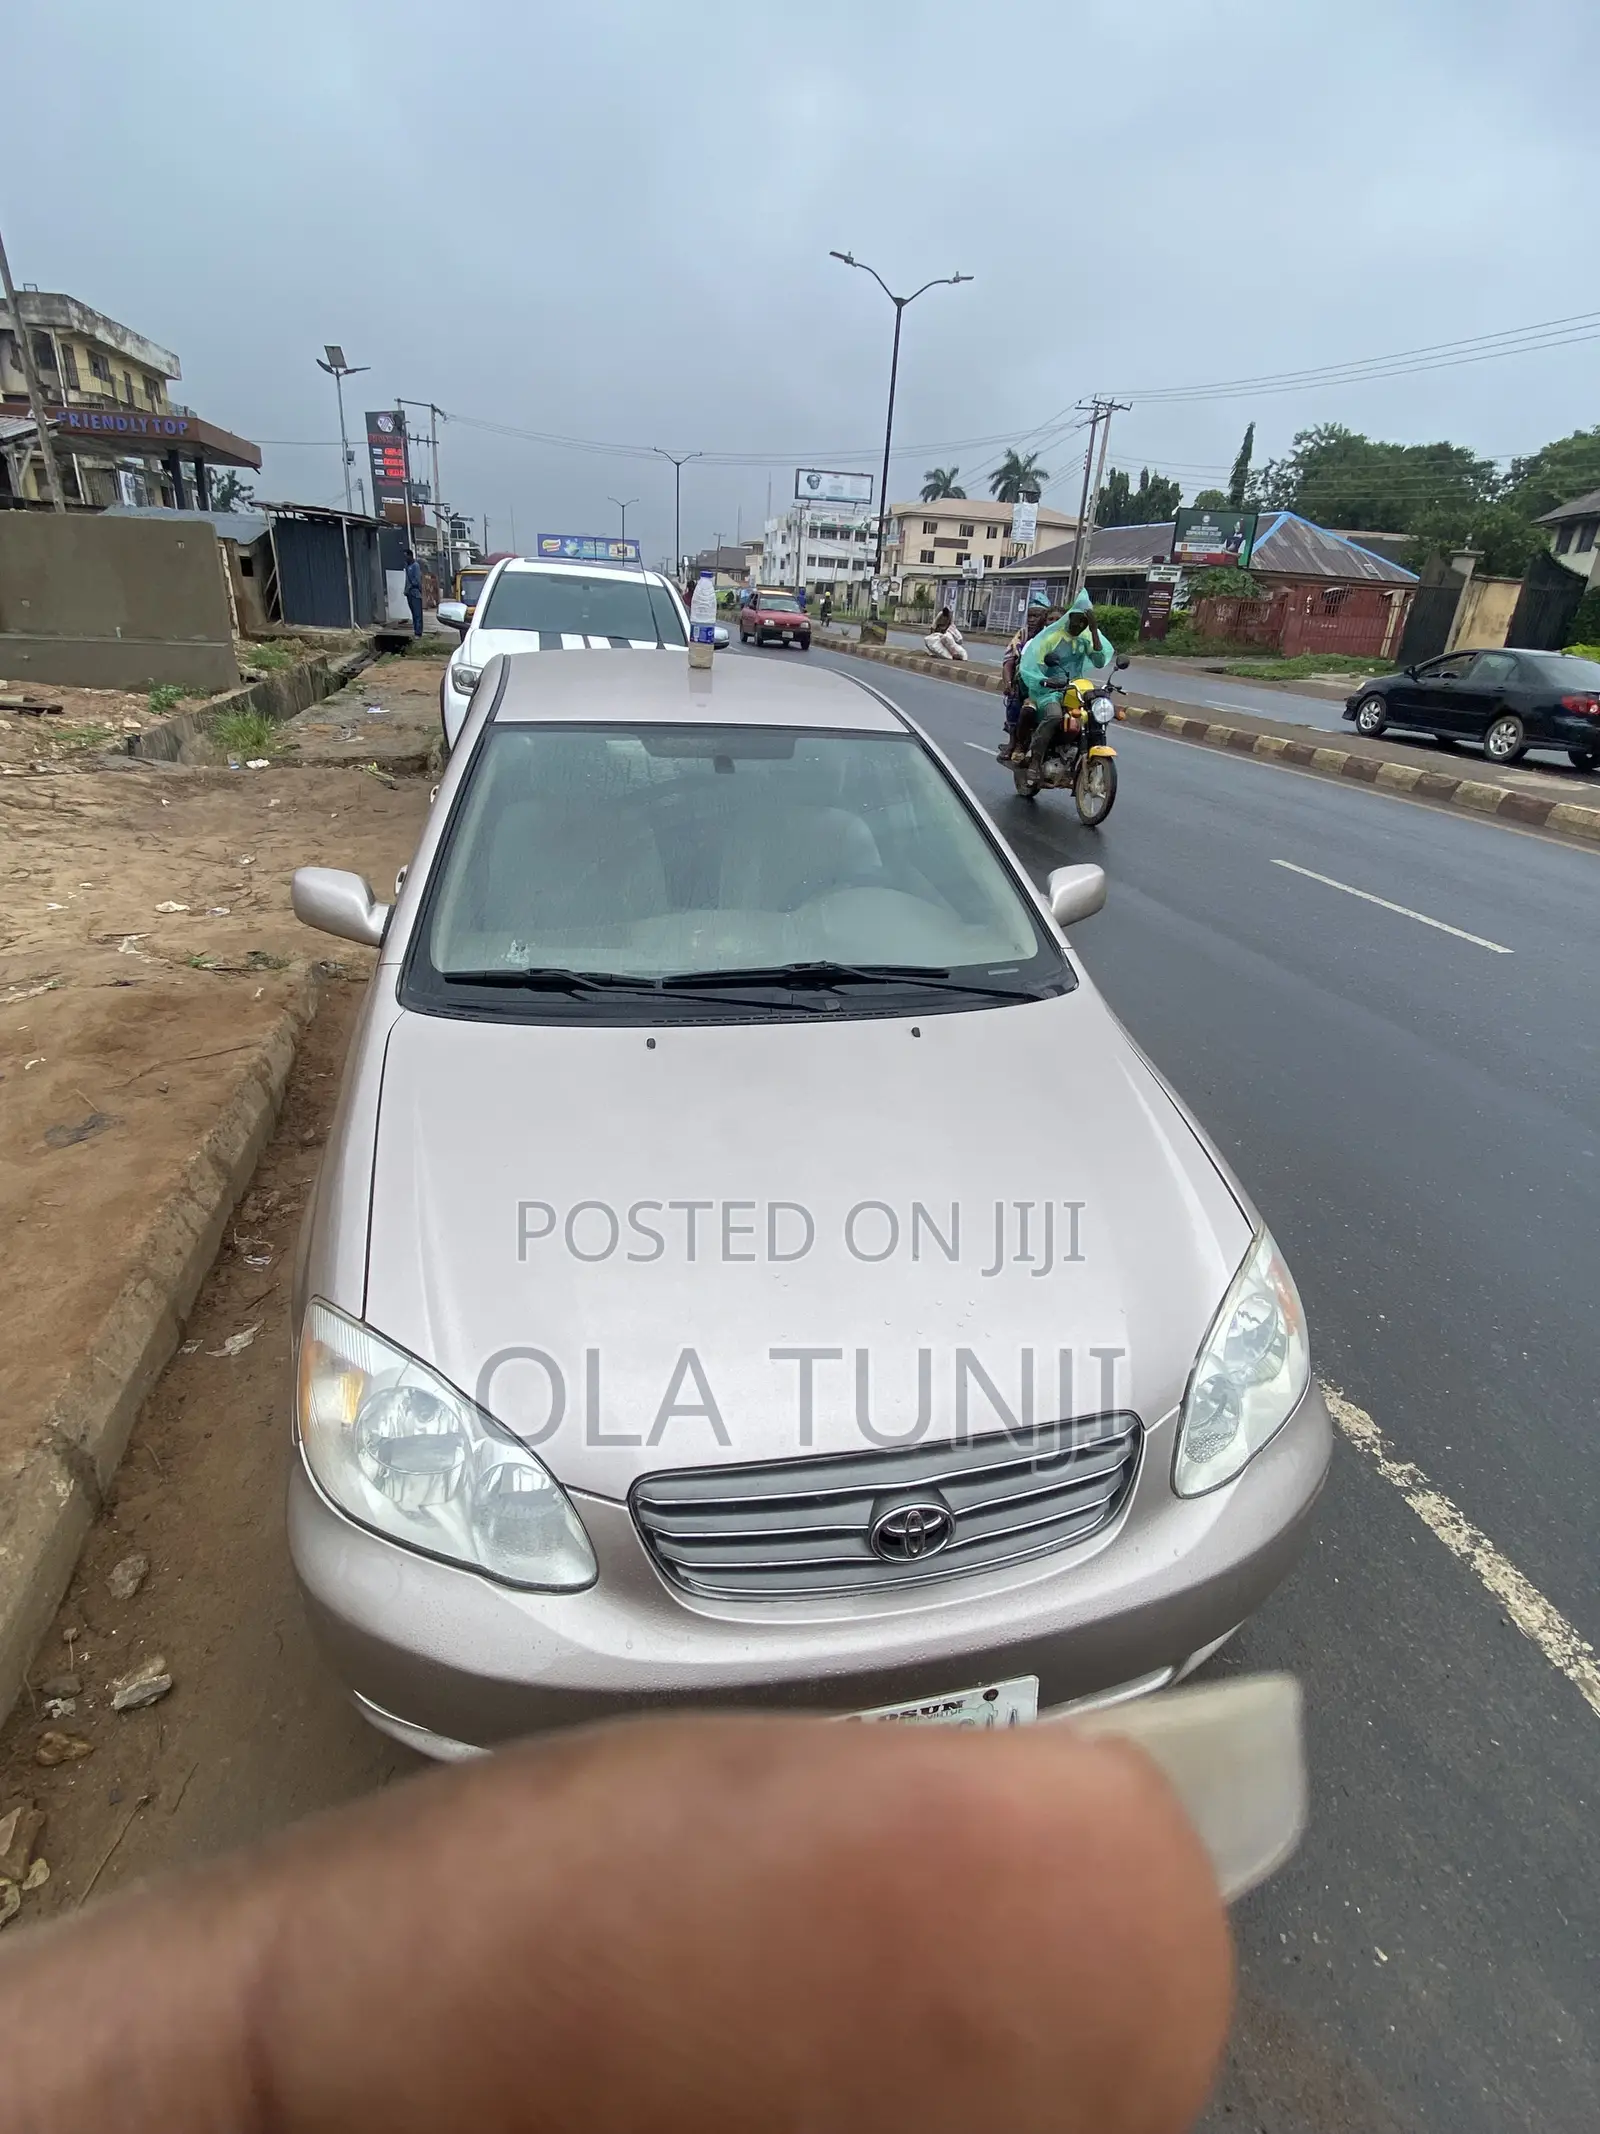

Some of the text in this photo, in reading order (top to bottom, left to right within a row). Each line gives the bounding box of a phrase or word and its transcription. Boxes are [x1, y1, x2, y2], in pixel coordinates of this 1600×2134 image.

[56, 411, 188, 435] FRIENDLY TOP
[878, 1700, 966, 1721] OSUN
